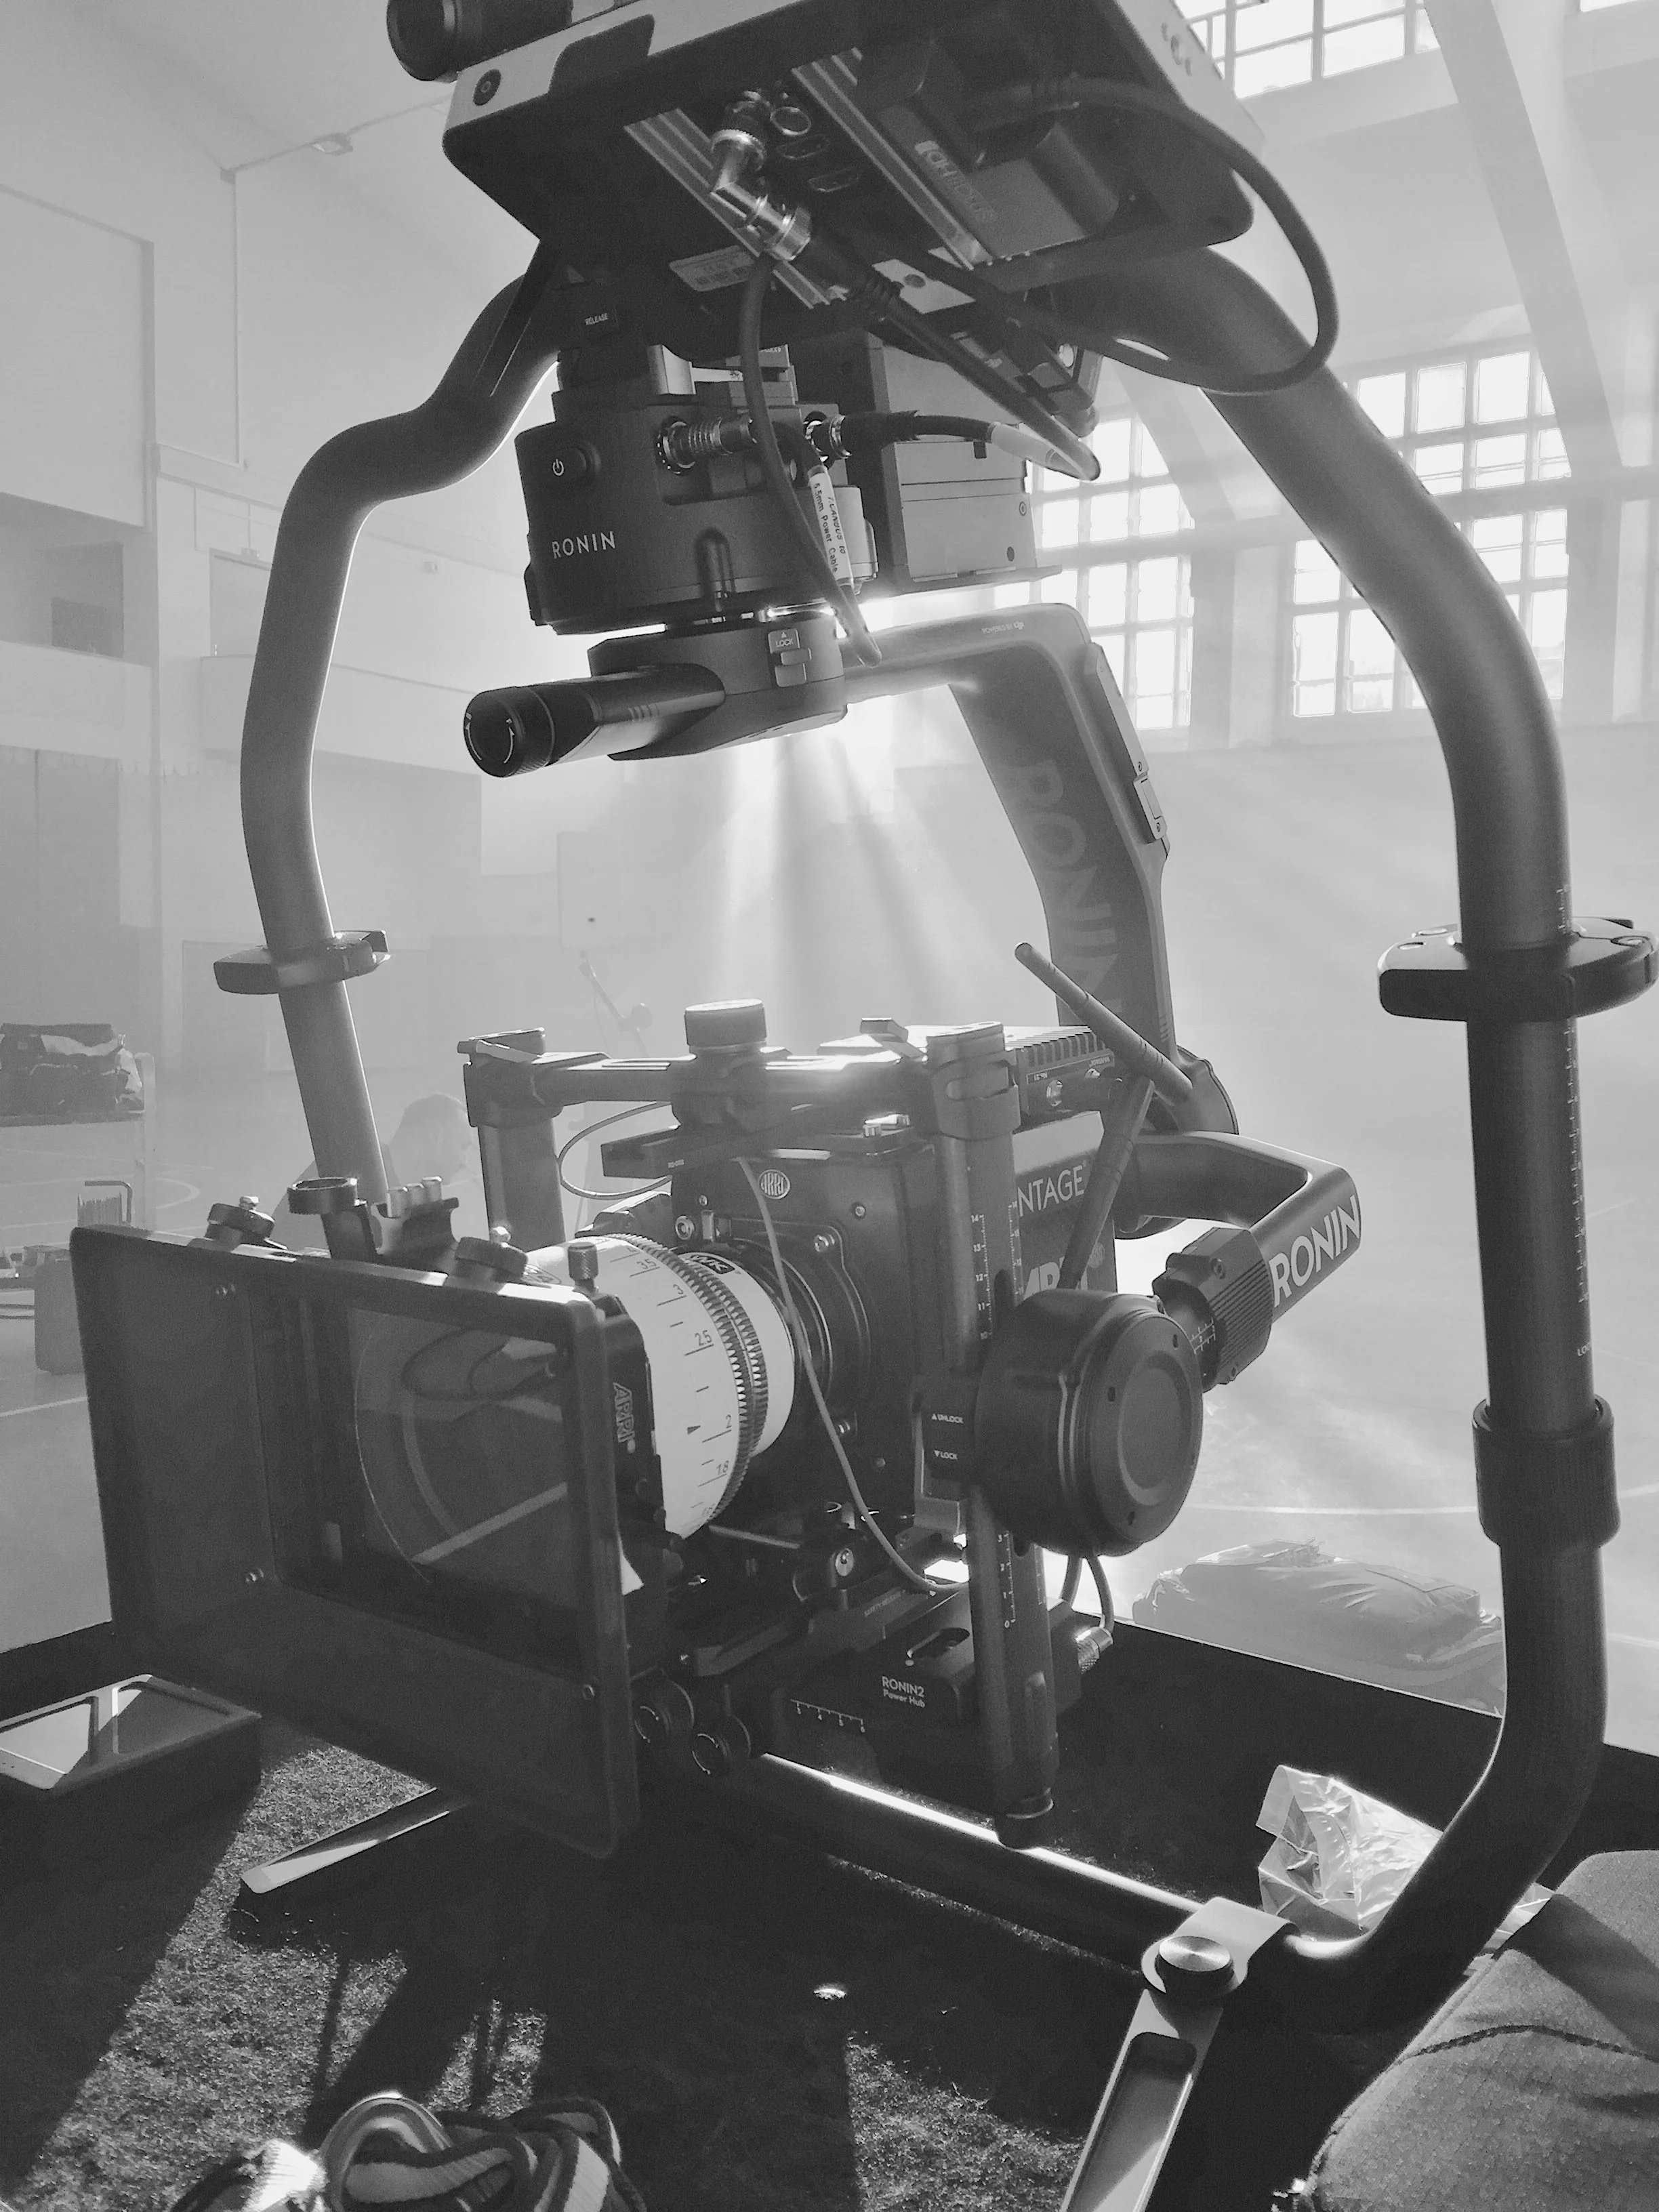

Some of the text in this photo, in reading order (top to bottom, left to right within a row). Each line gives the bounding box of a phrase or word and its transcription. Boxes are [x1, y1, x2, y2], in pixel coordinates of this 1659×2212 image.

[552, 531, 615, 559] RONIN
[821, 515, 832, 542] Power
[829, 548, 840, 573] Cable
[775, 637, 794, 647] LOCK
[1017, 1165, 1084, 1217] NTAGE
[1268, 1194, 1360, 1308] RONIN
[613, 1382, 636, 1443] ARRI
[726, 1414, 733, 1429] 2
[937, 1414, 964, 1424] UNLOCK
[940, 1451, 958, 1460] LOCK
[882, 1676, 924, 1698] RONIN2
[883, 1688, 926, 1708] Power Hub
